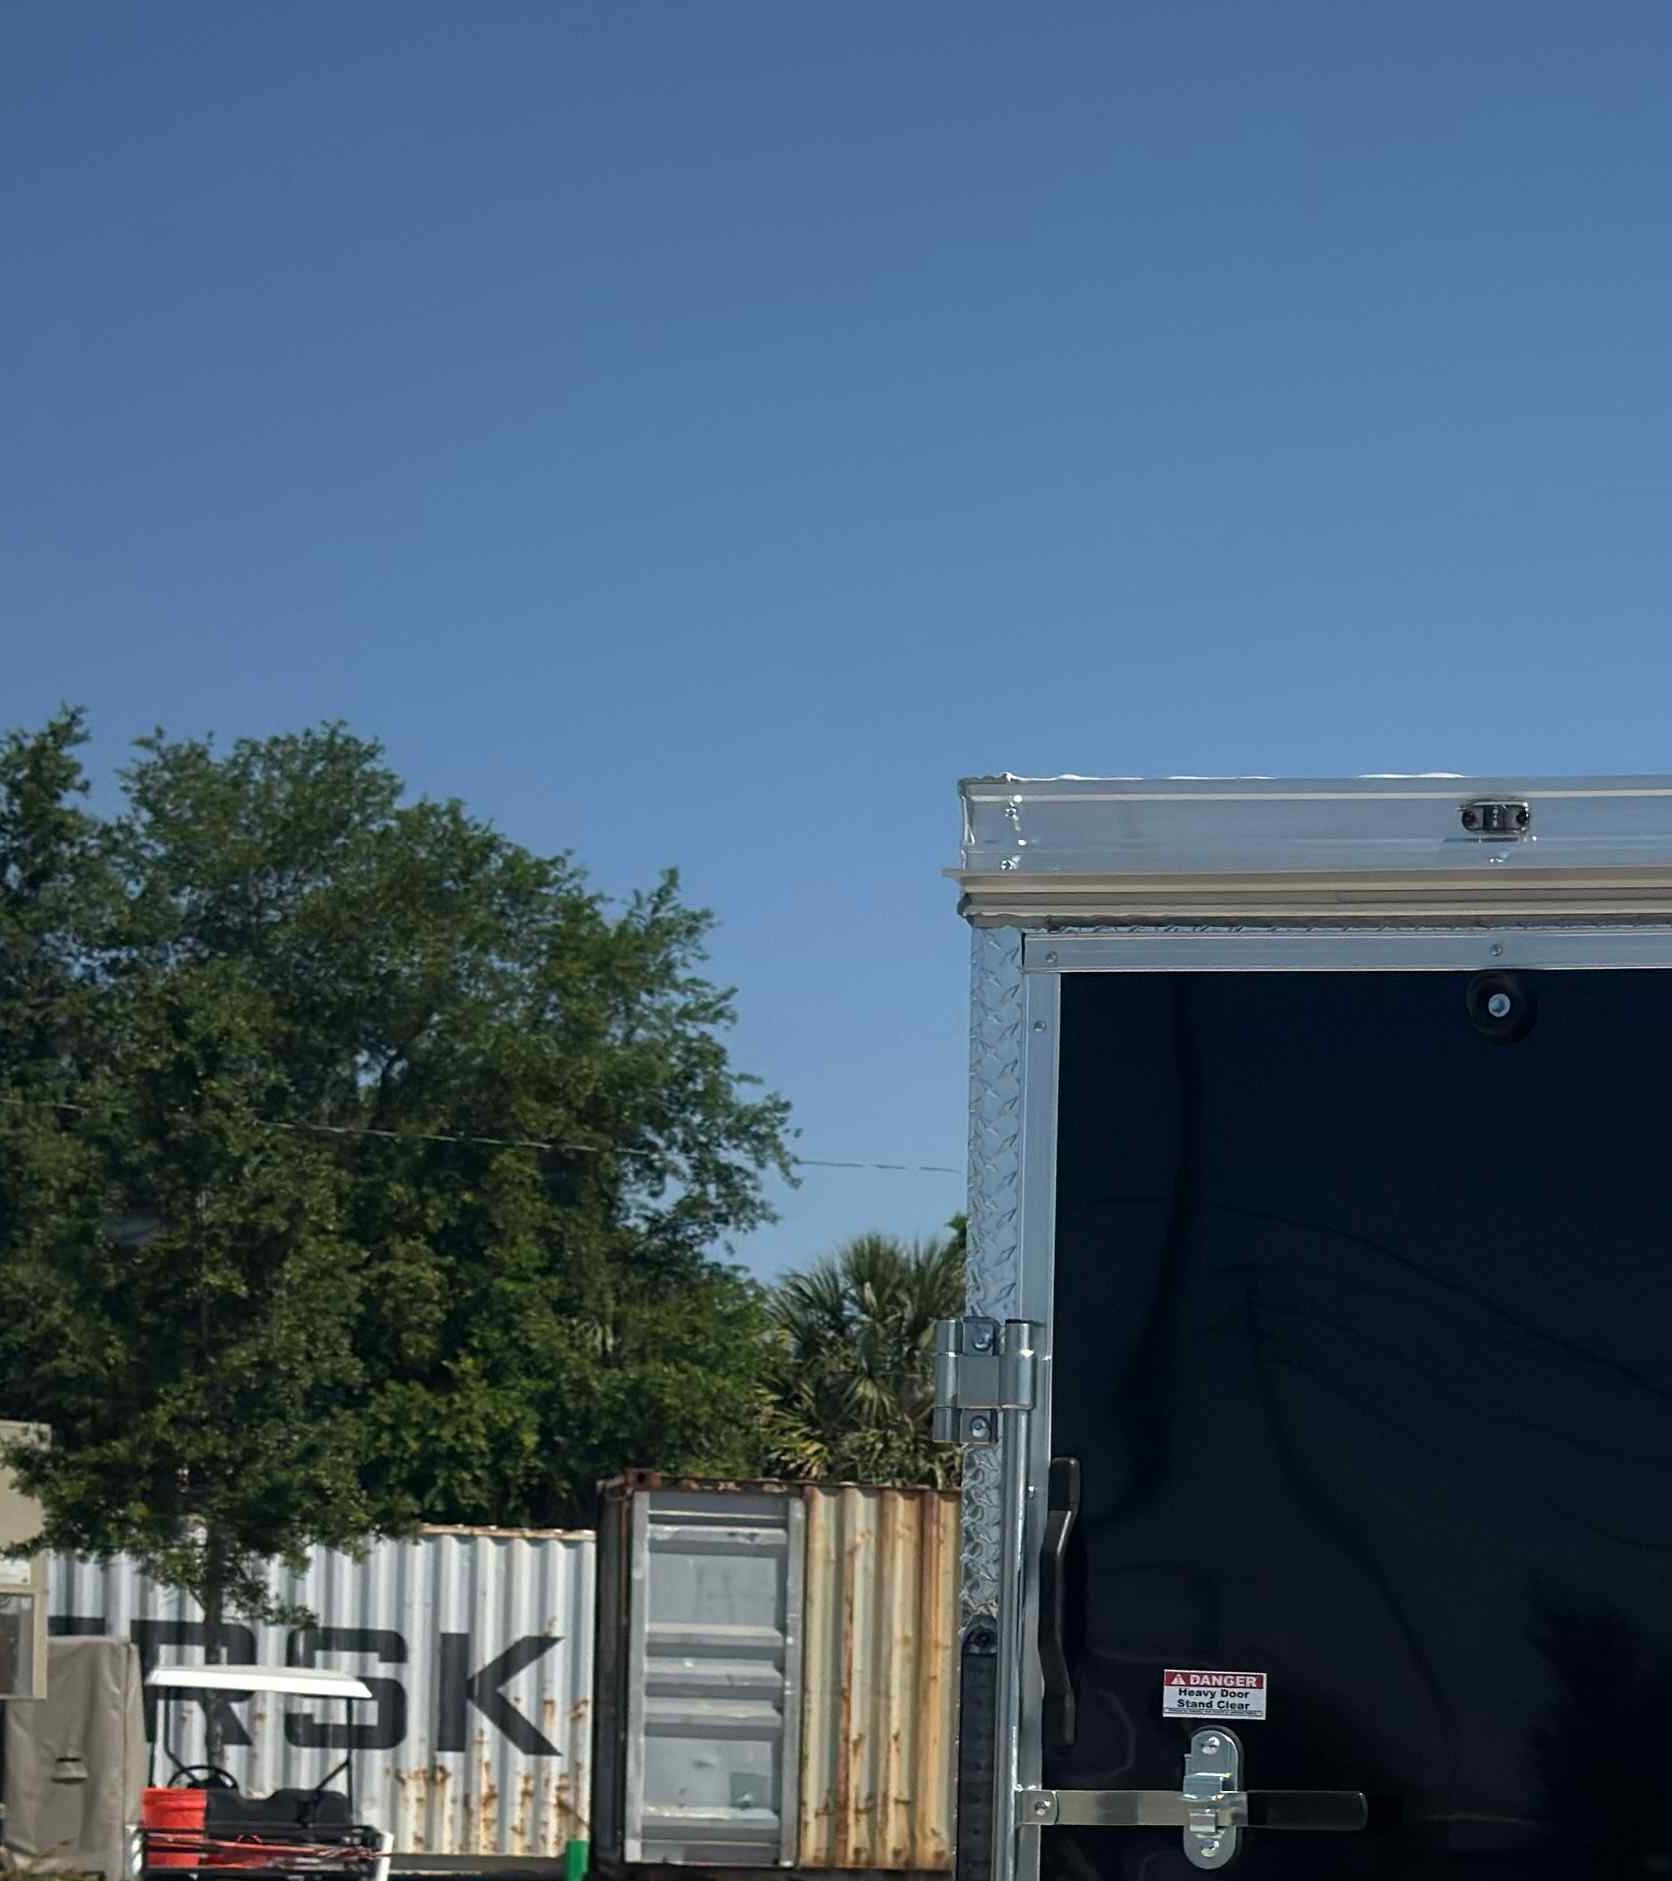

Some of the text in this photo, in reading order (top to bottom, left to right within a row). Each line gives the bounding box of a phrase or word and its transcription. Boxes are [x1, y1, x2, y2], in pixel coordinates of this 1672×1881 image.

[1189, 1673, 1257, 1688] DANGER
[1178, 1687, 1250, 1699] Heavy Door
[1177, 1698, 1251, 1710] Stand Clear
